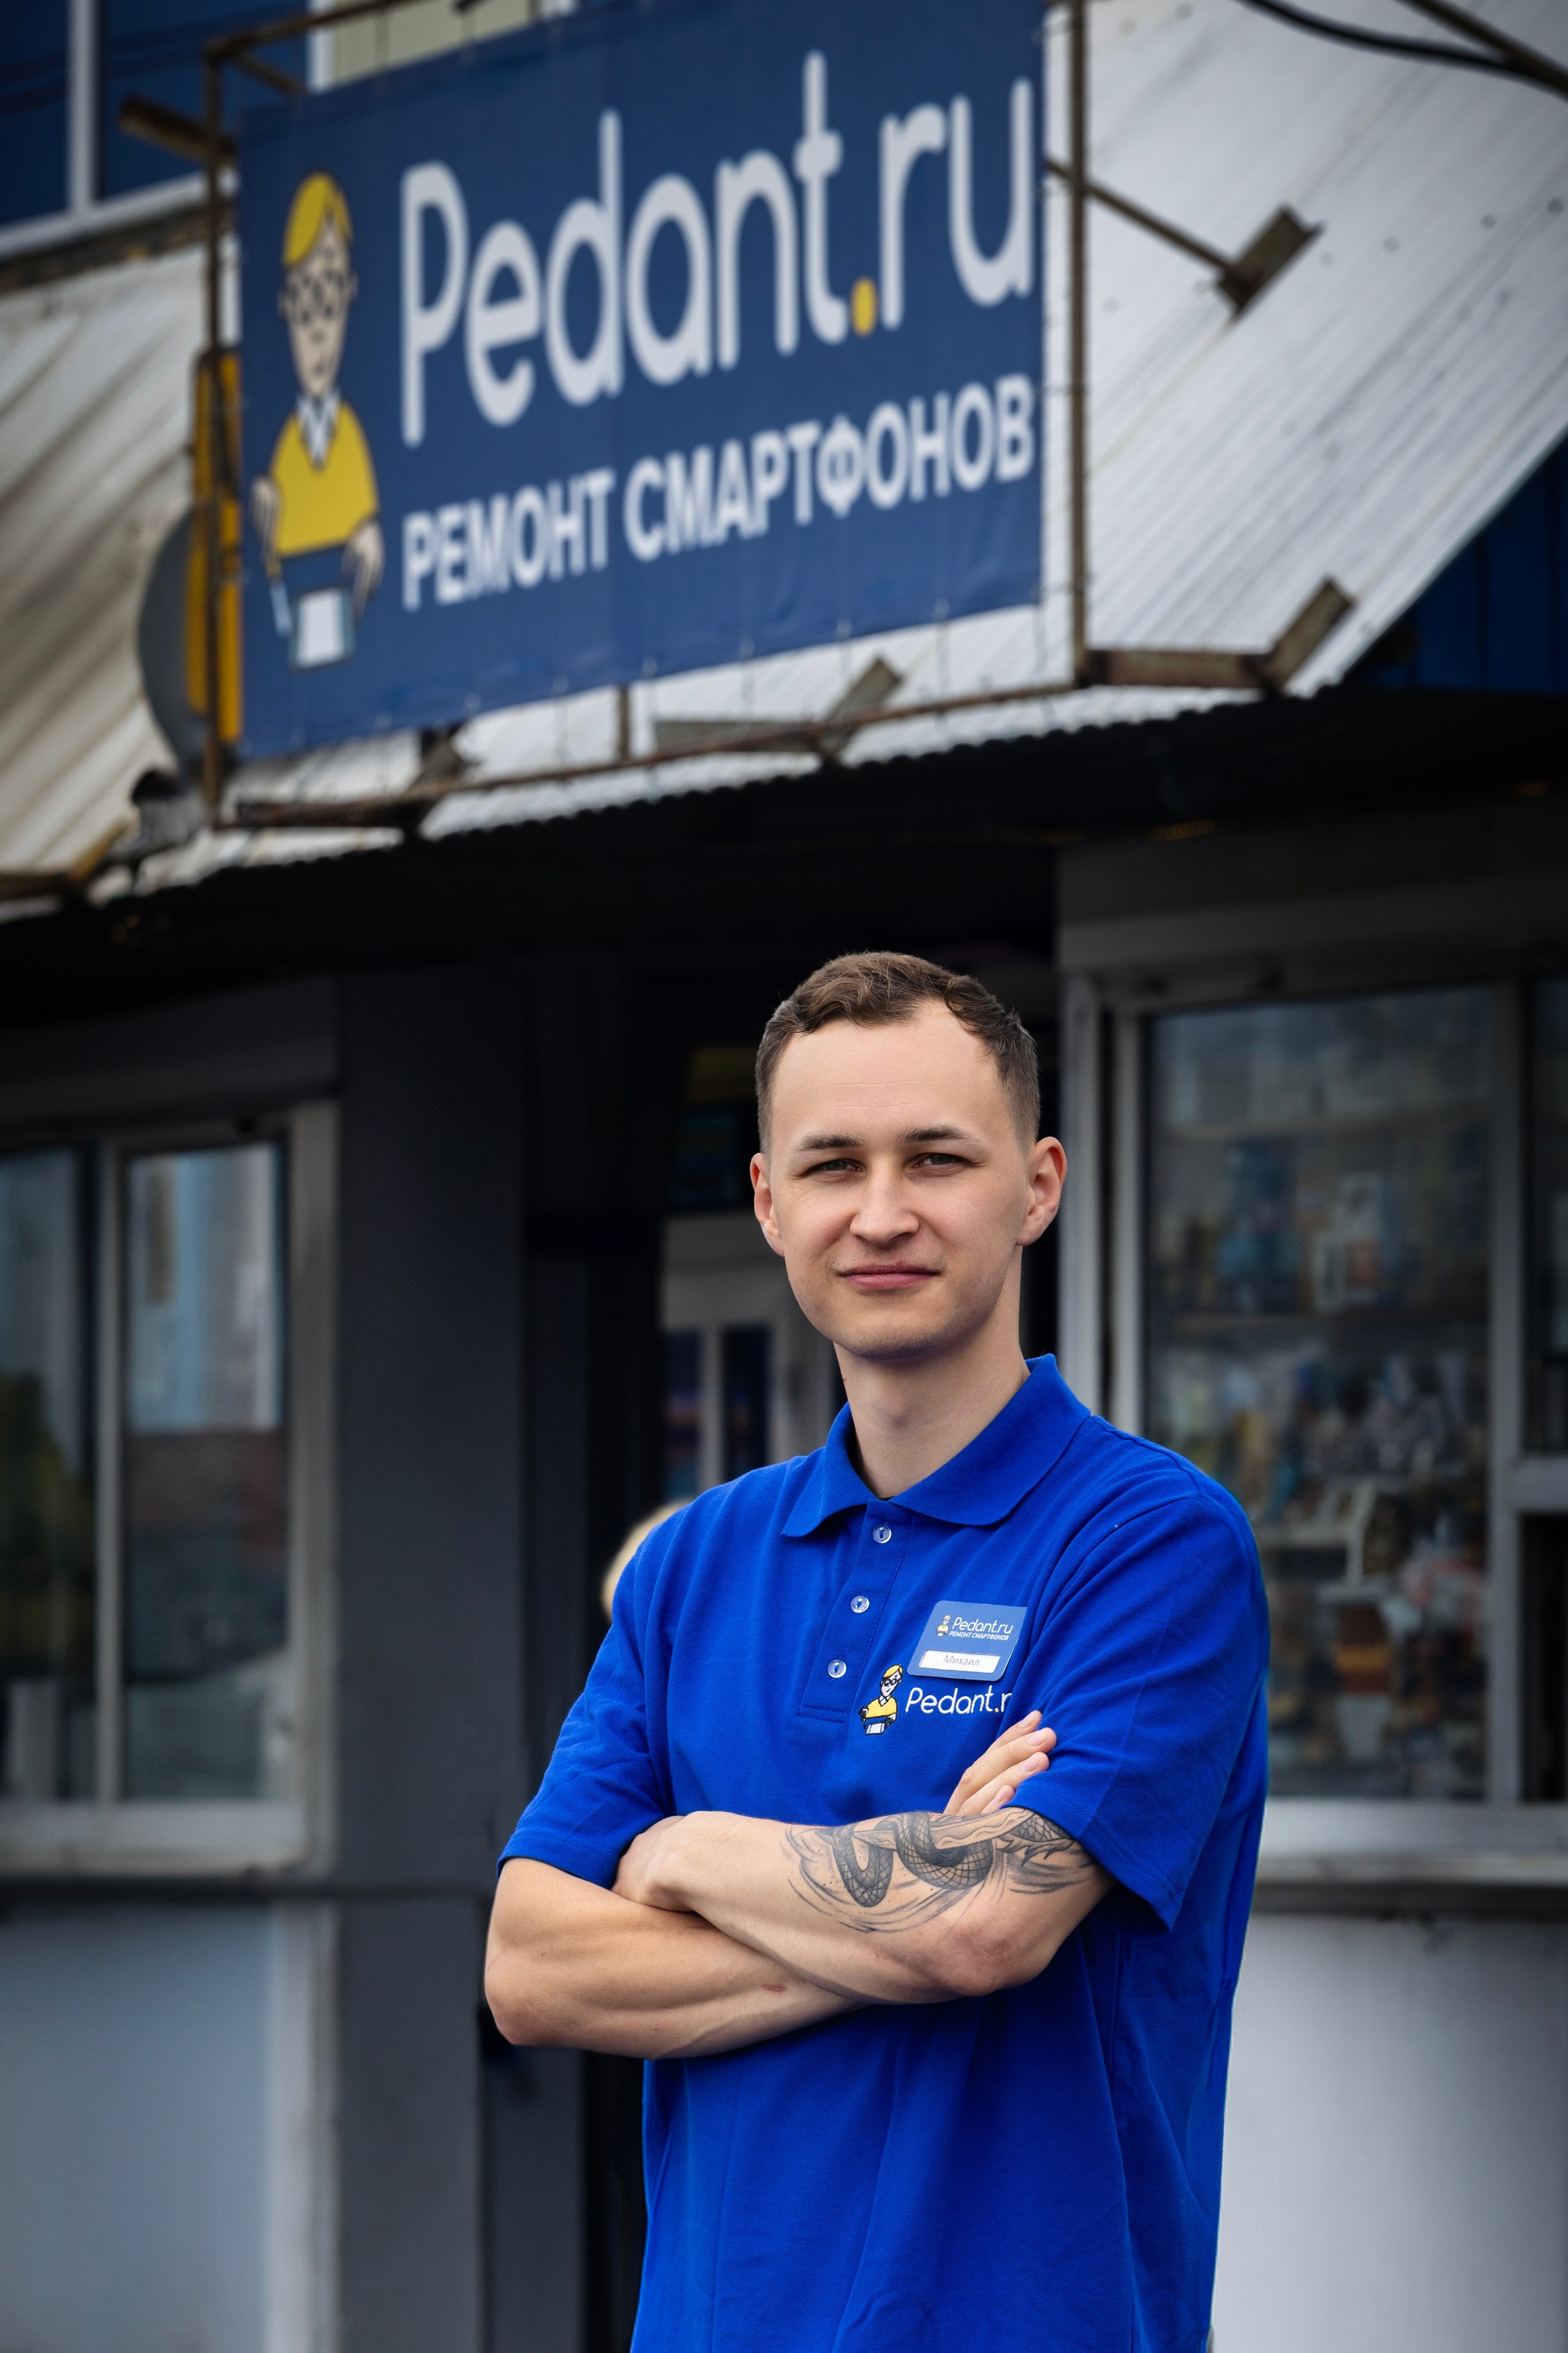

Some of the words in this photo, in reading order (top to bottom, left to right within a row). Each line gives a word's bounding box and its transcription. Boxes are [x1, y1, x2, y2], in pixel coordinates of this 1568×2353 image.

[401, 49, 1034, 447] Pedant.ru
[402, 468, 614, 610] РЕМОНТ
[623, 374, 1035, 561] СМАРТФОНОВ
[951, 1617, 1014, 1634] Pedant.ru
[943, 1655, 980, 1666] Михаил
[905, 1685, 1012, 1714] Pedant.r
